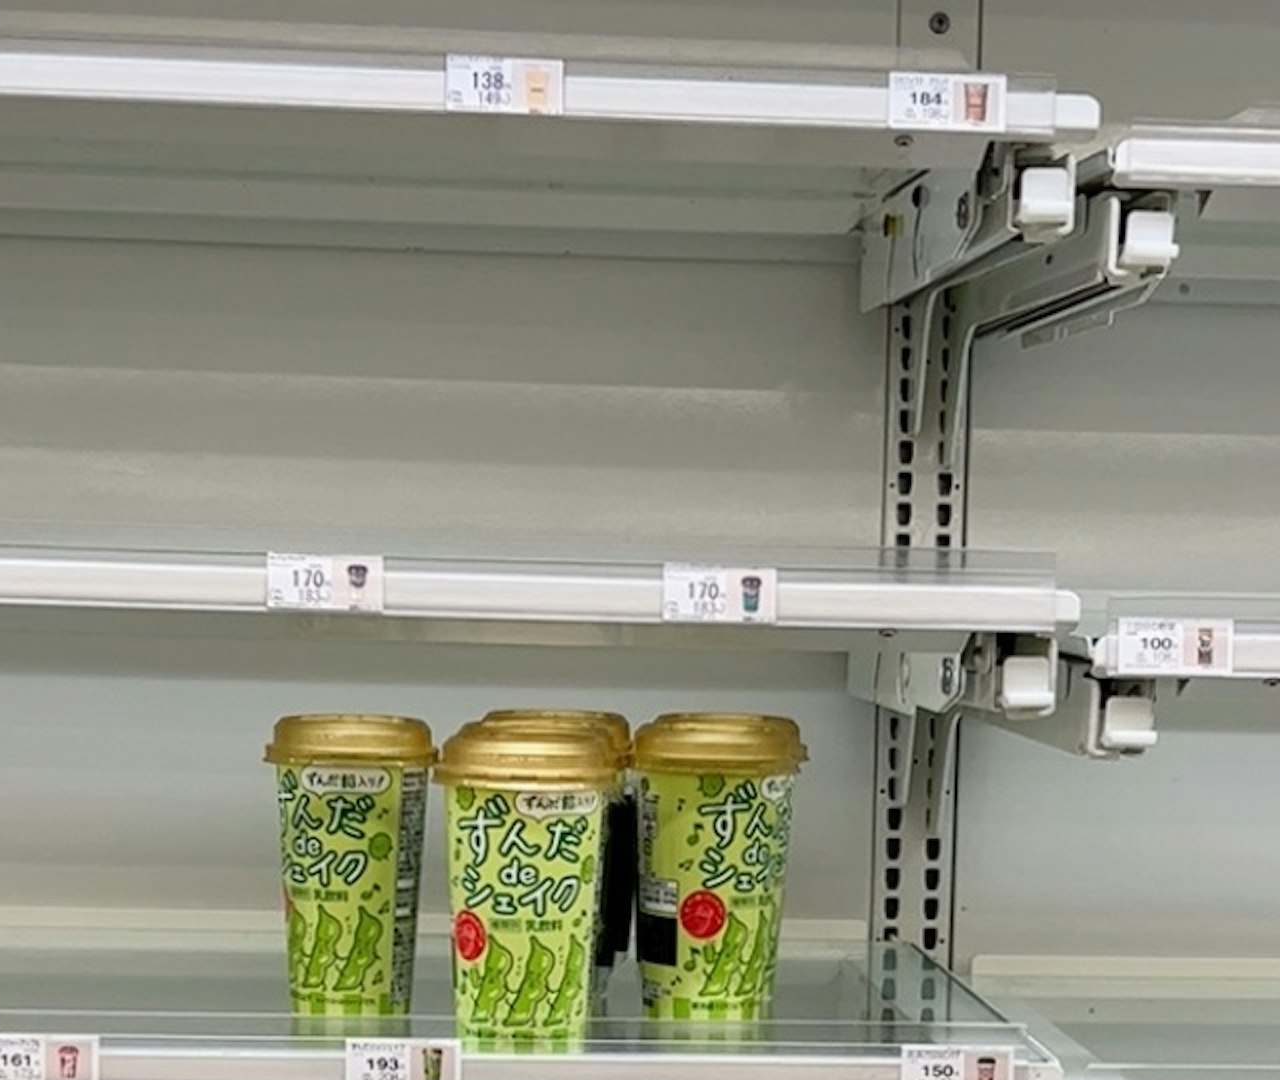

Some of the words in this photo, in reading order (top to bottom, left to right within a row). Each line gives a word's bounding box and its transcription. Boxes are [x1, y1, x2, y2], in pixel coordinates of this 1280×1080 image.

[293, 829, 322, 857] de
[457, 793, 588, 866] ずんだ
[460, 864, 580, 918] シェイク
[498, 857, 538, 887] de
